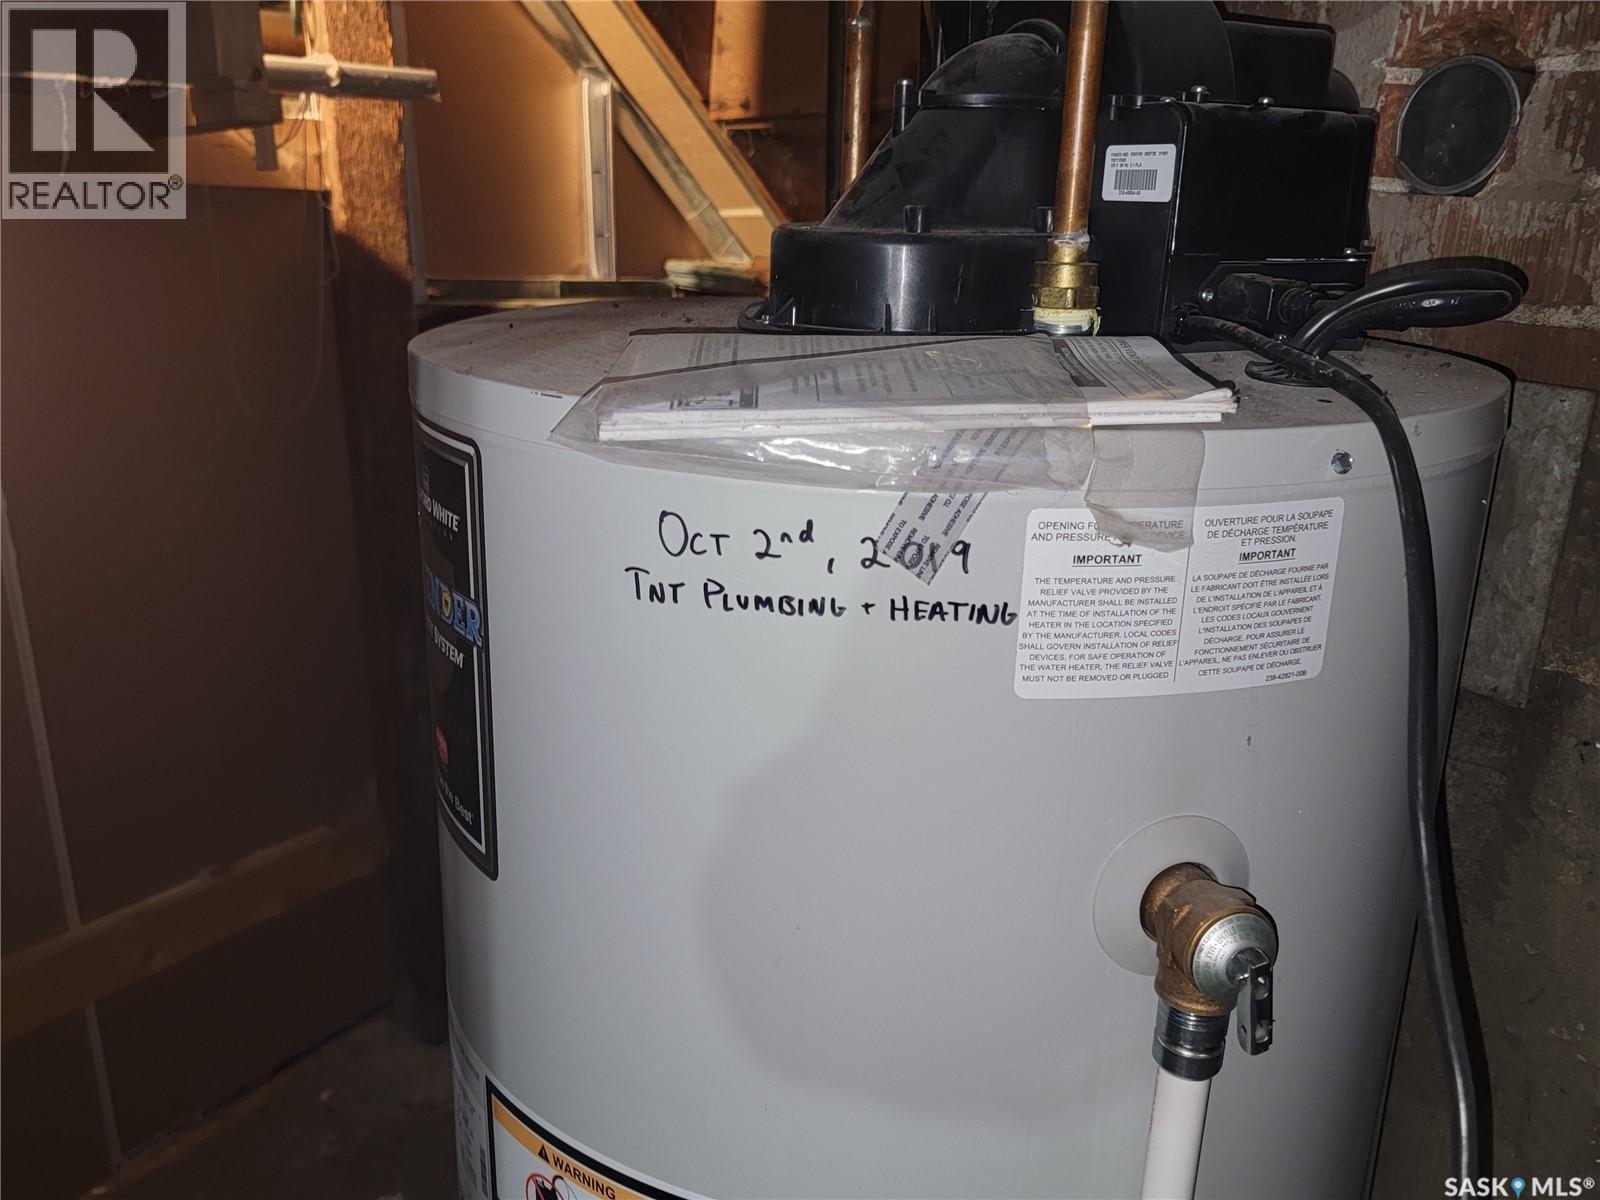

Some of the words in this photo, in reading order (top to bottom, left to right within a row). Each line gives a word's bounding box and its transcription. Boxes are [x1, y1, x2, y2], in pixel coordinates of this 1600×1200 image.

[432, 498, 460, 532] WHITE
[1205, 515, 1258, 528] OUVERTURE
[1260, 513, 1284, 523] POUR
[1286, 512, 1295, 521] LA
[1297, 509, 1334, 520] SOUPAPE
[1038, 521, 1085, 530] OPENING
[1088, 521, 1100, 530] FO
[1207, 529, 1218, 539] DE
[1222, 525, 1270, 538] DÉCHARGE
[1272, 521, 1329, 534] TEMPÉRATURE
[1031, 533, 1052, 541] AND
[1056, 532, 1111, 541] PRESSURE
[1241, 538, 1252, 547] ET
[1073, 554, 1142, 564] IMPORTANT
[1239, 548, 1296, 561] IMPORTANT
[1192, 574, 1201, 582] LA
[1203, 571, 1237, 581] SOUPAPE
[1239, 570, 1249, 578] DE
[1316, 563, 1329, 571] PAR
[1054, 576, 1113, 584] TEMPERATURE
[1134, 575, 1176, 583] PRESSURE
[1201, 581, 1241, 592] FABRICANT
[1243, 579, 1258, 588] DOIT
[1040, 588, 1069, 596] RELIEF
[1100, 587, 1140, 595] PROVIDED
[1196, 595, 1206, 603] DE
[1309, 585, 1317, 593] ET
[703, 577, 848, 617] PLUMBING
[889, 594, 1019, 627] HEATING
[1028, 598, 1096, 607] MANUFACTURER
[1137, 597, 1177, 605] INSTALLED
[1264, 599, 1277, 607] PAR
[1278, 598, 1286, 606] LE
[1027, 610, 1037, 618] AT
[1079, 609, 1090, 617] OF
[1092, 608, 1147, 616] INSTALLATION
[1201, 615, 1215, 624] LES
[1217, 613, 1241, 622] CODES
[1242, 610, 1269, 619] LOCAUX
[1029, 621, 1061, 629] HEATER
[1074, 620, 1089, 628] THE
[1092, 619, 1131, 627] LOCATION
[1134, 619, 1173, 627] SPECIFIED
[1254, 620, 1267, 629] DES
[1268, 617, 1302, 627] SOUPAPES
[1304, 616, 1312, 624] DE
[1150, 629, 1177, 637] CODES
[1246, 631, 1265, 641] POUR
[1266, 628, 1296, 639] ASSURER
[1297, 627, 1305, 636] LE
[1019, 642, 1044, 650] SHALL
[1083, 640, 1138, 649] INSTALLATION
[1140, 640, 1150, 648] OF
[1302, 637, 1310, 645] DE
[1069, 652, 1085, 660] FOR
[1110, 651, 1153, 659] OPERATION
[1156, 650, 1166, 658] OF
[1222, 654, 1232, 662] NE
[1233, 652, 1247, 661] PAS
[1248, 649, 1278, 659] ENLEVER
[1289, 644, 1322, 654] OBSTRUER
[1038, 663, 1066, 671] WATER
[1122, 661, 1148, 669] RELIEF
[1150, 660, 1173, 668] VALVE
[1198, 667, 1220, 677] CETTE
[1222, 663, 1254, 674] SOUPAPE
[1256, 662, 1265, 670] DE
[1047, 674, 1063, 682] NOT
[1078, 673, 1117, 681] REMOVED
[1119, 672, 1131, 680] OR
[551, 1153, 616, 1200] WARNING
